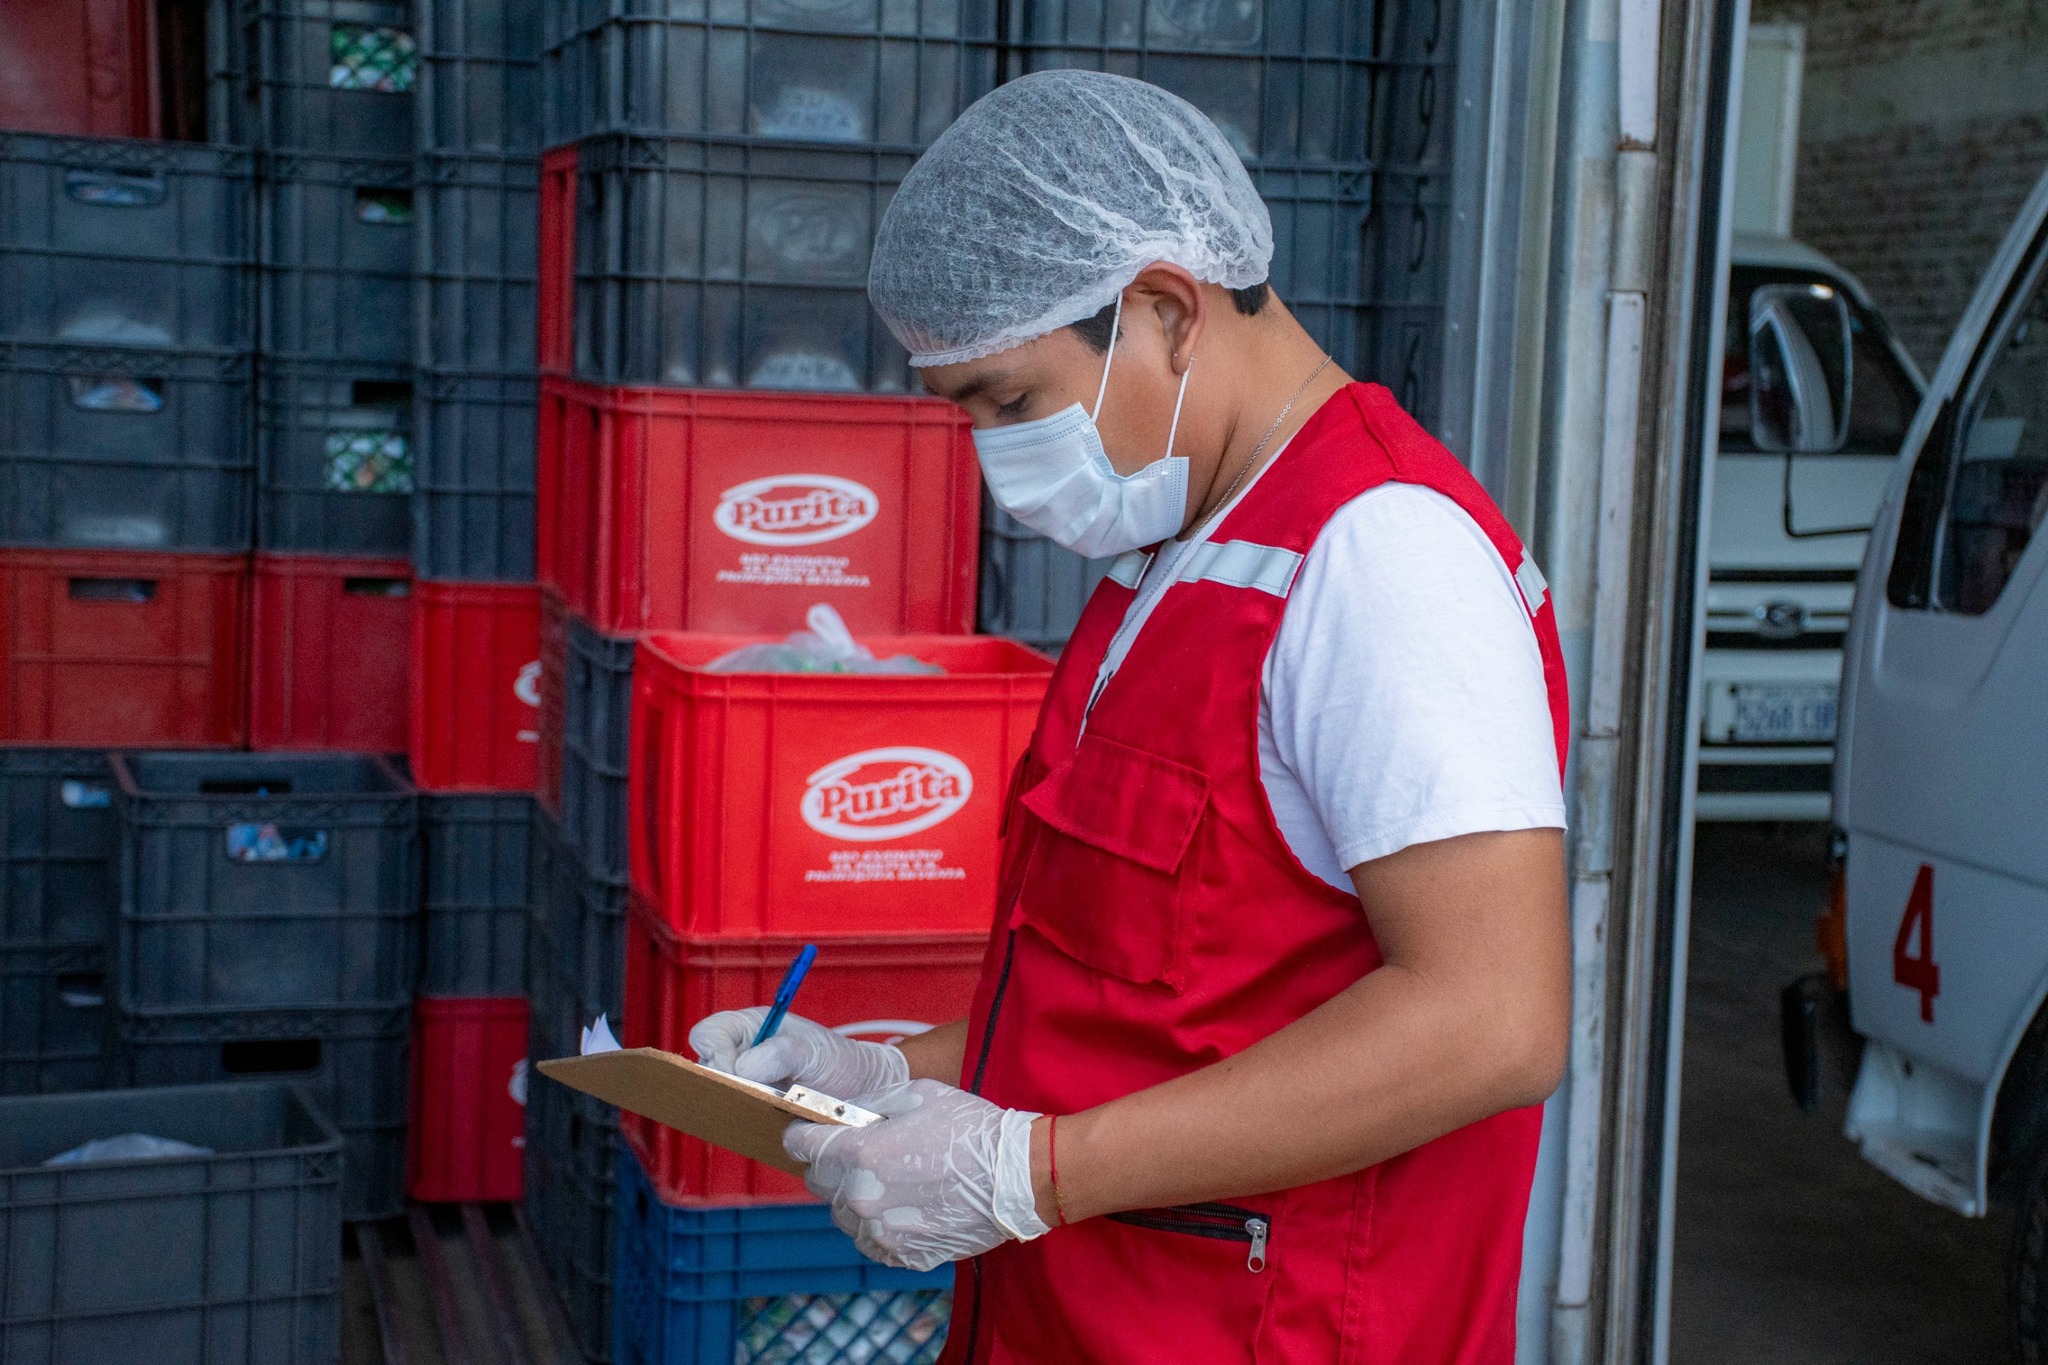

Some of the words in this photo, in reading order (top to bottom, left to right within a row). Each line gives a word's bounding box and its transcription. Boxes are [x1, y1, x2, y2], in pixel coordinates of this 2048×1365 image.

[732, 493, 867, 527] Purita
[820, 770, 961, 820] Purita
[1893, 864, 1940, 1023] 4
